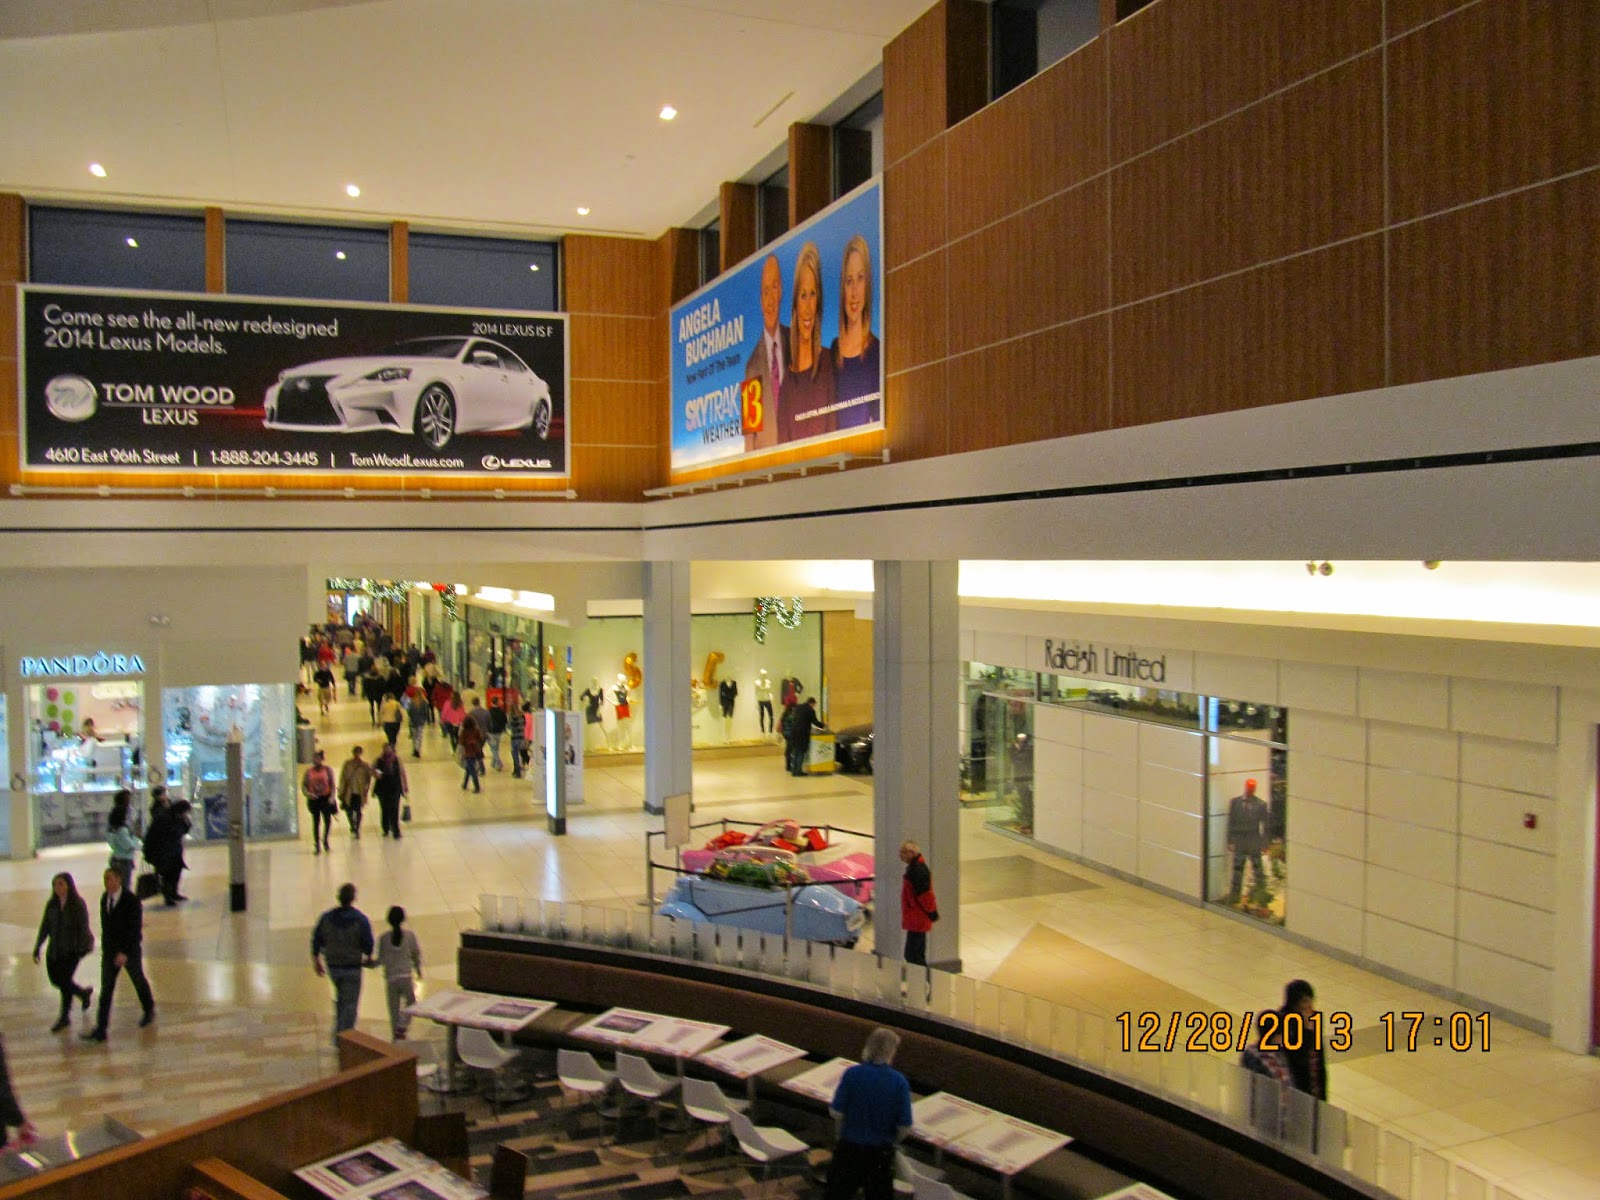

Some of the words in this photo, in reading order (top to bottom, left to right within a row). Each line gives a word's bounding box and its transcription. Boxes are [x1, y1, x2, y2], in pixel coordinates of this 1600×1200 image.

[43, 303, 105, 327] Come
[107, 313, 139, 329] see
[142, 308, 172, 330] the
[175, 310, 240, 332] all-new
[243, 314, 339, 340] redesigned
[472, 321, 498, 335] 2014
[500, 323, 535, 337] LEXUS
[678, 298, 721, 343] ANGELA
[43, 326, 96, 349] 2014
[99, 329, 152, 351] Lexus
[156, 331, 228, 354] Models.
[685, 315, 744, 368] BUCHMAN
[102, 383, 154, 402] TOM
[160, 385, 236, 405] WOOD
[685, 382, 741, 432] SKYTRAK
[742, 378, 764, 430] 13
[142, 408, 200, 426] LEXUS
[703, 419, 741, 445] WEATHER
[45, 447, 79, 463] 4610
[81, 448, 109, 464] East
[110, 448, 142, 464] 96th
[143, 448, 181, 465] Street
[350, 452, 465, 469] TomWoodLexus.com
[501, 458, 552, 468] LEXUS
[21, 651, 145, 677] PANDORA
[1044, 639, 1098, 675] Raleigh
[1104, 646, 1166, 683] Limited
